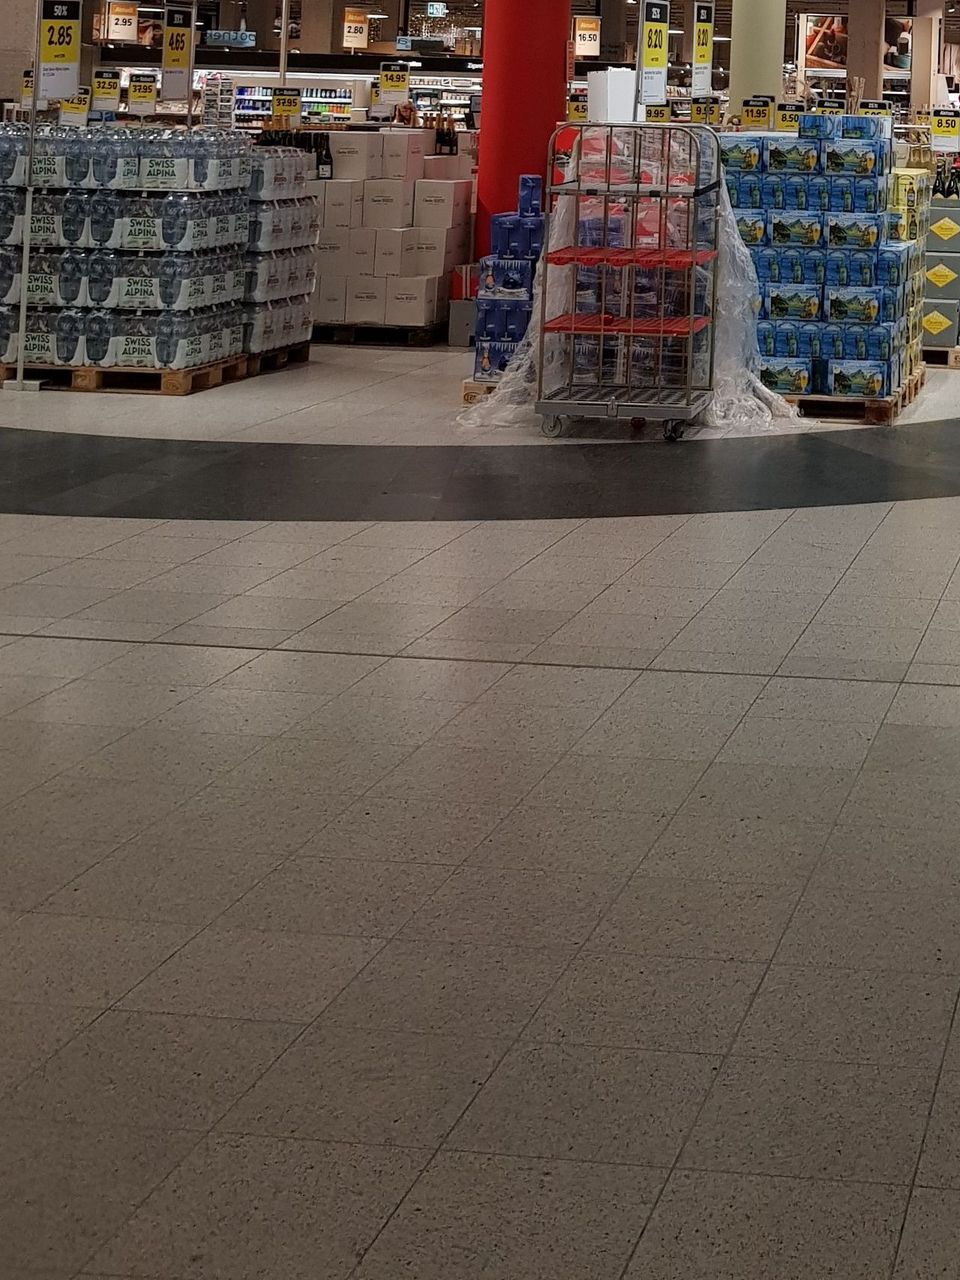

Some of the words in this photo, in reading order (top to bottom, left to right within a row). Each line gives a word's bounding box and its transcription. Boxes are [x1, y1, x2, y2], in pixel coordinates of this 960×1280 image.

[54, 5, 68, 16] 50%
[347, 25, 364, 35] 2.80
[47, 26, 72, 46] 2.85
[578, 34, 597, 42] 16.50
[648, 28, 663, 49] 8.20
[697, 28, 708, 47] 8.20
[168, 32, 186, 51] 4.65
[384, 74, 406, 83] 14.95
[96, 81, 118, 90] 32.50
[132, 85, 153, 93] 37.95
[276, 98, 298, 107] 37.95
[744, 109, 767, 118] 11.95
[781, 114, 799, 122] 8.50
[937, 119, 956, 128] 8.50
[32, 157, 56, 166] SWISS
[150, 159, 175, 169] SWISS
[32, 167, 57, 175] ALPINA
[31, 216, 55, 225] SWISS
[130, 219, 156, 228] SWISS
[30, 226, 56, 234] ALPINA
[128, 229, 157, 237] ALPINA
[27, 275, 53, 284] SWISS
[127, 278, 153, 288] SWISS
[26, 285, 54, 294] ALPINA
[124, 288, 155, 297] ALPINA
[24, 334, 50, 344] SWISS
[124, 337, 151, 346] SWISS
[24, 344, 50, 352] ALPINA
[122, 347, 152, 356] ALPINA
